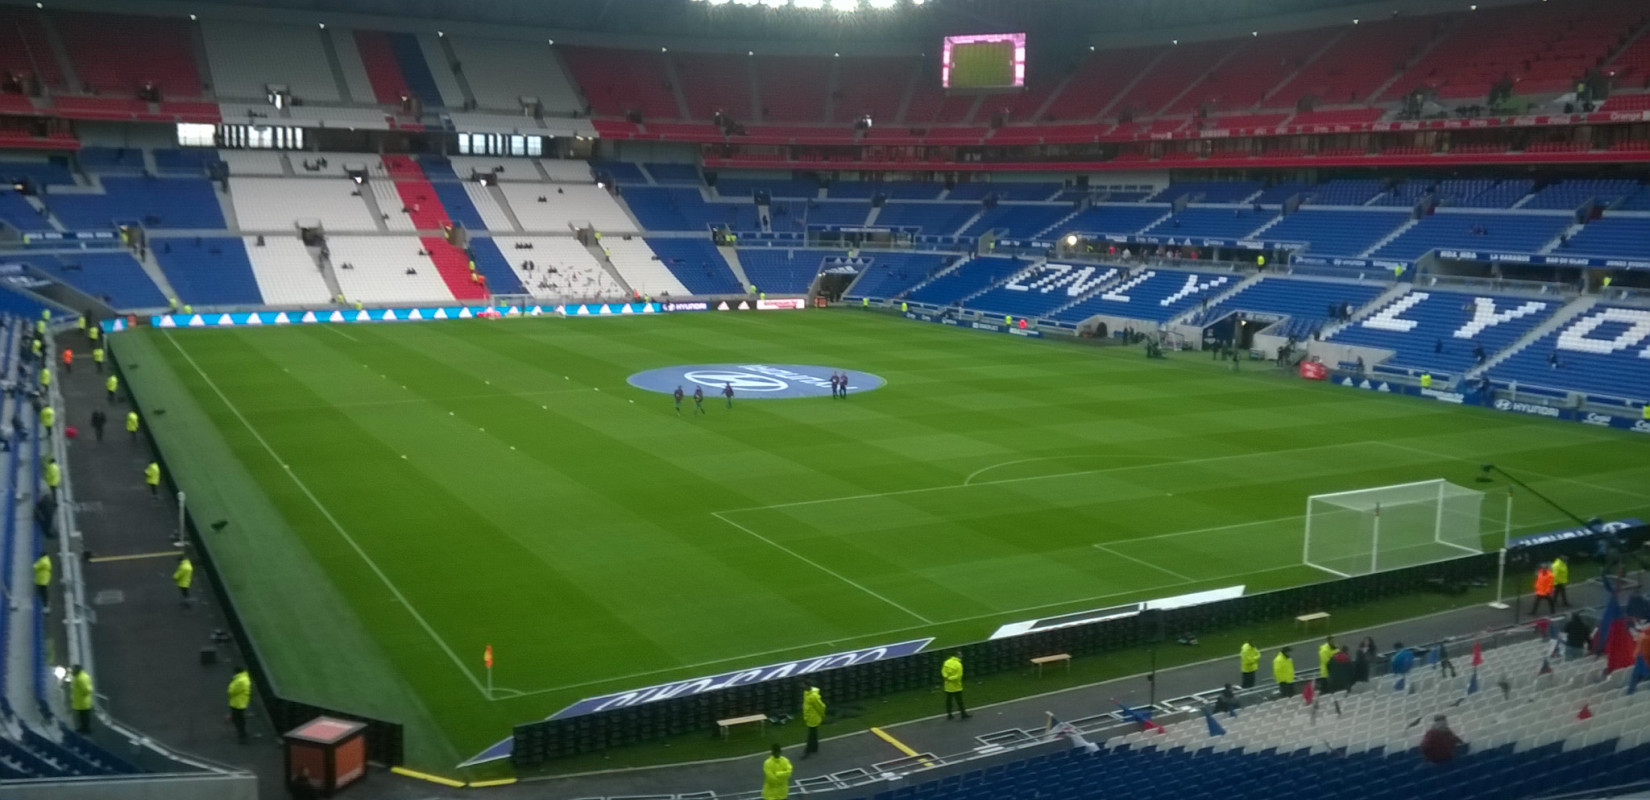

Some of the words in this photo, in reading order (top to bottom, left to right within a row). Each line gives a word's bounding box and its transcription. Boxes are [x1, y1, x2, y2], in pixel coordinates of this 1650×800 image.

[675, 302, 707, 311] HYUNDAI
[1361, 292, 1650, 359] LYO
[1512, 402, 1560, 418] HYUNDAI
